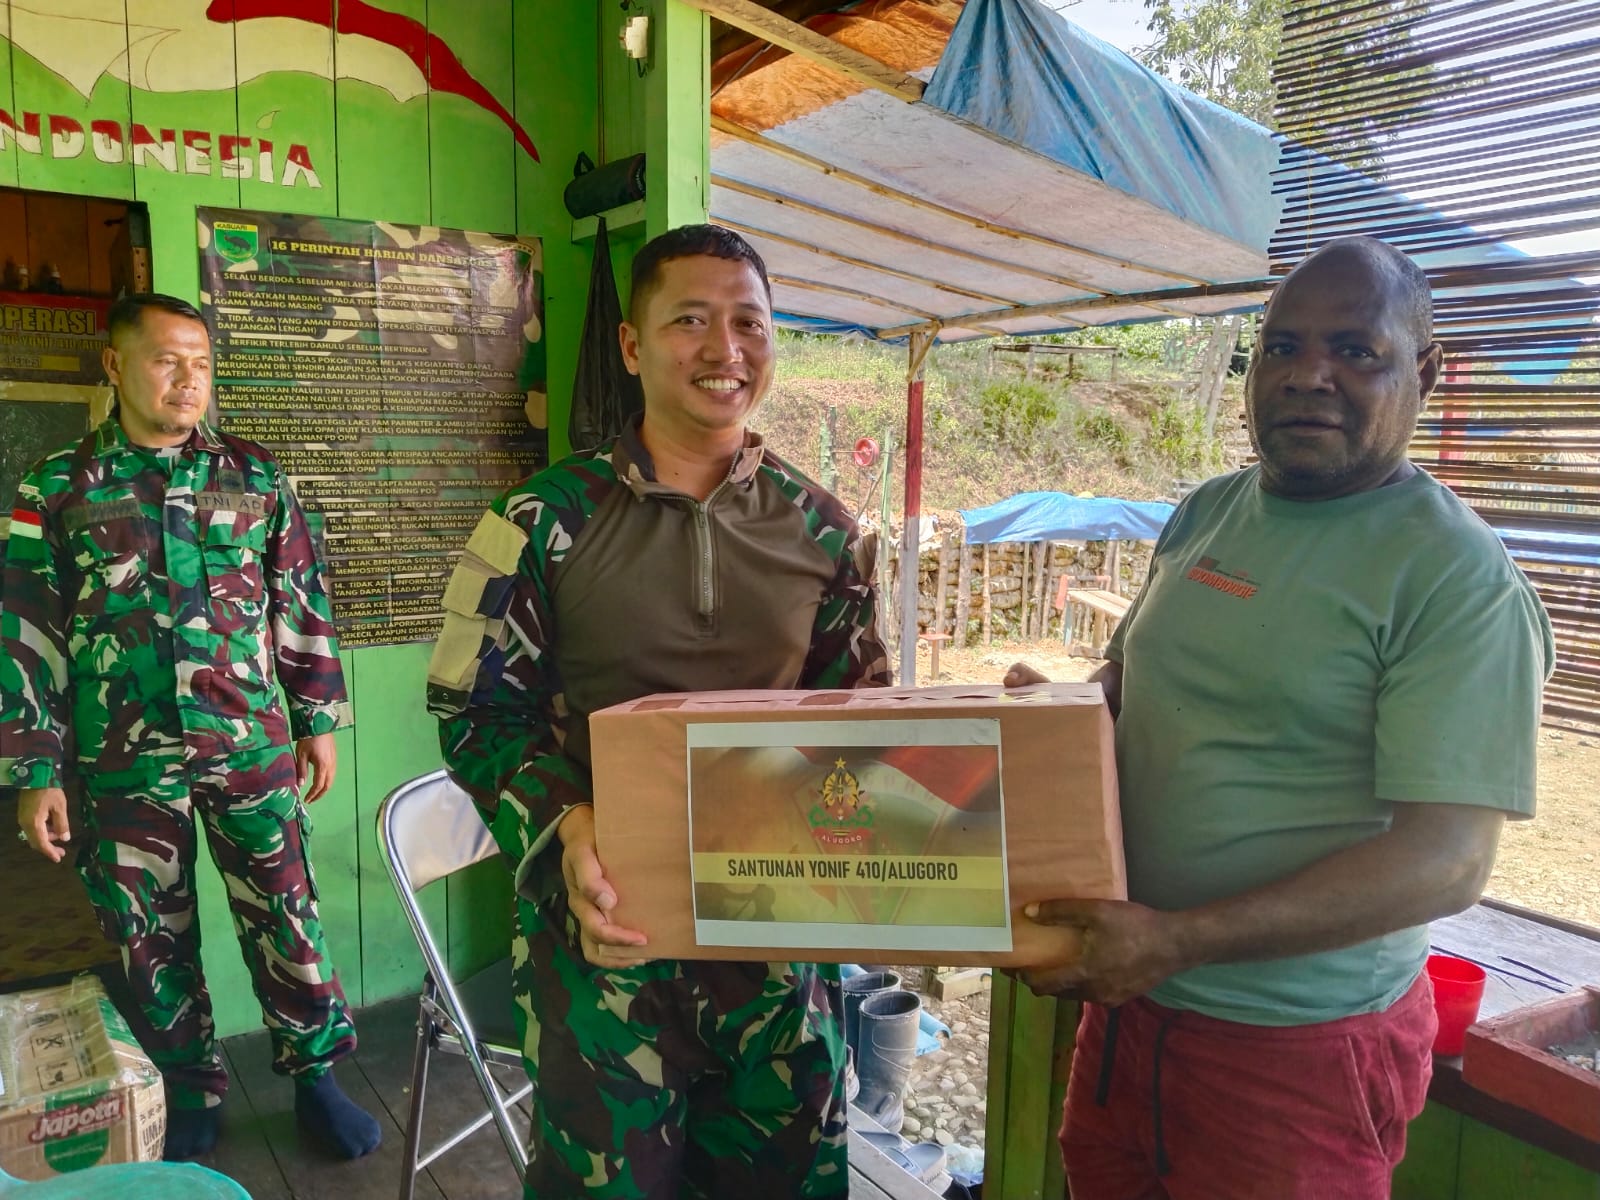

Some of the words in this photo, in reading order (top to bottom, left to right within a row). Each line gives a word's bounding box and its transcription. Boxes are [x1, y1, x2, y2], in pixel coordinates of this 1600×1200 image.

[216, 223, 248, 232] KASUARI
[272, 240, 288, 251] 16
[290, 242, 360, 256] PERINTAH
[364, 248, 415, 261] HARIAN
[224, 273, 256, 281] SELALU
[258, 275, 294, 284] BERDOA
[296, 278, 334, 287] SEBELUM
[336, 280, 406, 292] MELAKSANAKAN
[228, 290, 286, 300] TINGKATKAN
[287, 294, 320, 303] IBADAH
[322, 296, 354, 304] KEPADA
[357, 298, 385, 306] TUHAN
[387, 300, 409, 308] YANG
[250, 300, 286, 309] MASING
[288, 302, 323, 311] MASING
[228, 314, 254, 322] TIDAK
[304, 318, 330, 326] AMAN
[240, 324, 276, 332] JANGAN
[278, 326, 317, 334] LENGAH)
[270, 340, 308, 348] TERLEBIH
[310, 342, 344, 350] DAHULU
[384, 345, 428, 353] BERTINDAK
[230, 353, 260, 361] FOKUS
[381, 359, 412, 367] MELAKS
[216, 362, 272, 370] MERUGIKAN
[295, 372, 358, 380] MENGABAIKAN
[231, 385, 289, 393] TINGKATKAN
[291, 386, 322, 394] NALURI
[345, 387, 379, 396] DISIPLIN
[382, 397, 432, 405] DIMANAPUN
[258, 402, 312, 410] PERUBAHAN
[436, 406, 488, 414] MASYARAKAT
[316, 488, 341, 496] SERTA
[384, 487, 419, 495] DINDING
[203, 495, 231, 507] TNI
[239, 500, 262, 510] AD
[322, 502, 366, 510] TERAPKAN
[331, 524, 350, 532] DAN
[380, 536, 440, 544] PELANGGARAN
[330, 545, 392, 554] PELAKSANAAN
[393, 544, 420, 552] TUGAS
[373, 558, 412, 566] BERMEDIA
[335, 567, 390, 575] MEMPOSTING
[396, 578, 439, 586] INFORMASI
[335, 589, 358, 597] YANG
[387, 586, 421, 594] DISADAP
[349, 602, 372, 610] JAGA
[373, 599, 419, 609] KESEHATAN
[335, 609, 385, 619] (UTAMAKAN
[386, 606, 439, 616] PENGOBATAN
[351, 623, 382, 631] SEGERA
[384, 620, 428, 629] LAPORKAN
[342, 631, 373, 640] SEKECIL
[374, 629, 407, 637] APAPUN
[340, 638, 368, 647] JARING
[370, 635, 420, 645] KOMUNIKASI
[821, 834, 864, 845] ALUGORO
[727, 859, 805, 878] SANTUNAN
[808, 860, 850, 879] YONIF
[856, 861, 958, 882] 410/ALUGORO
